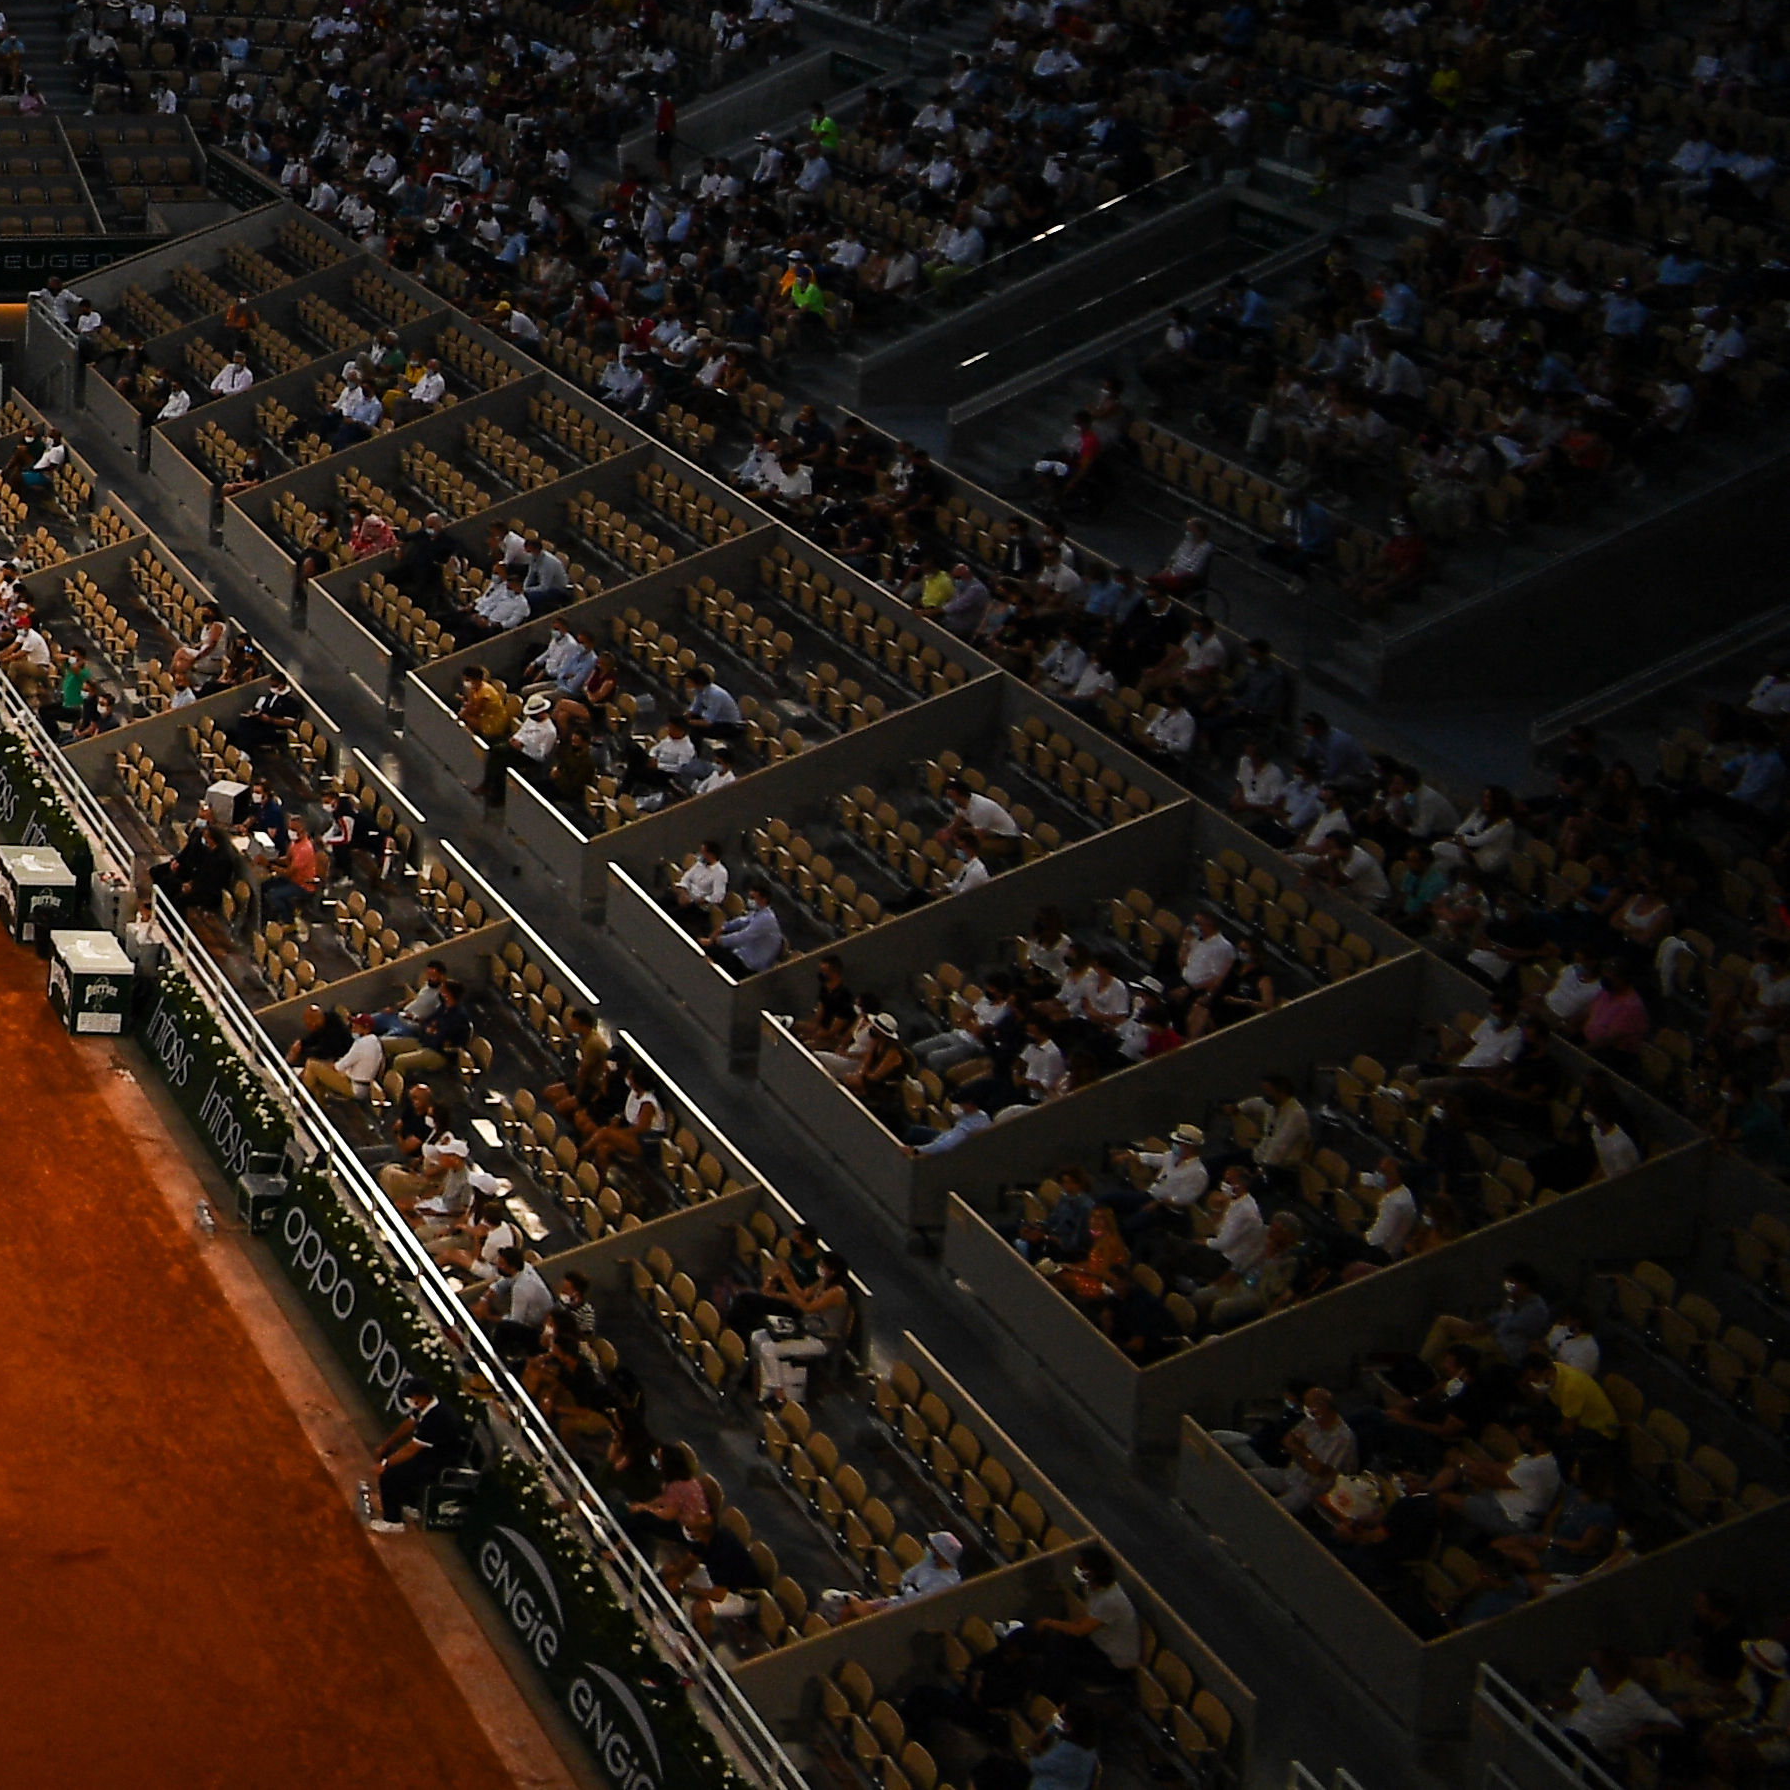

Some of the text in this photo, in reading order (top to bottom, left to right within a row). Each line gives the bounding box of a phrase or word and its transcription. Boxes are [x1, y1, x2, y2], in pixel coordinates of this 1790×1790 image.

[147, 996, 195, 1088] Infosys
[199, 1076, 252, 1175] Infosys
[283, 1206, 415, 1416] oppo opp
